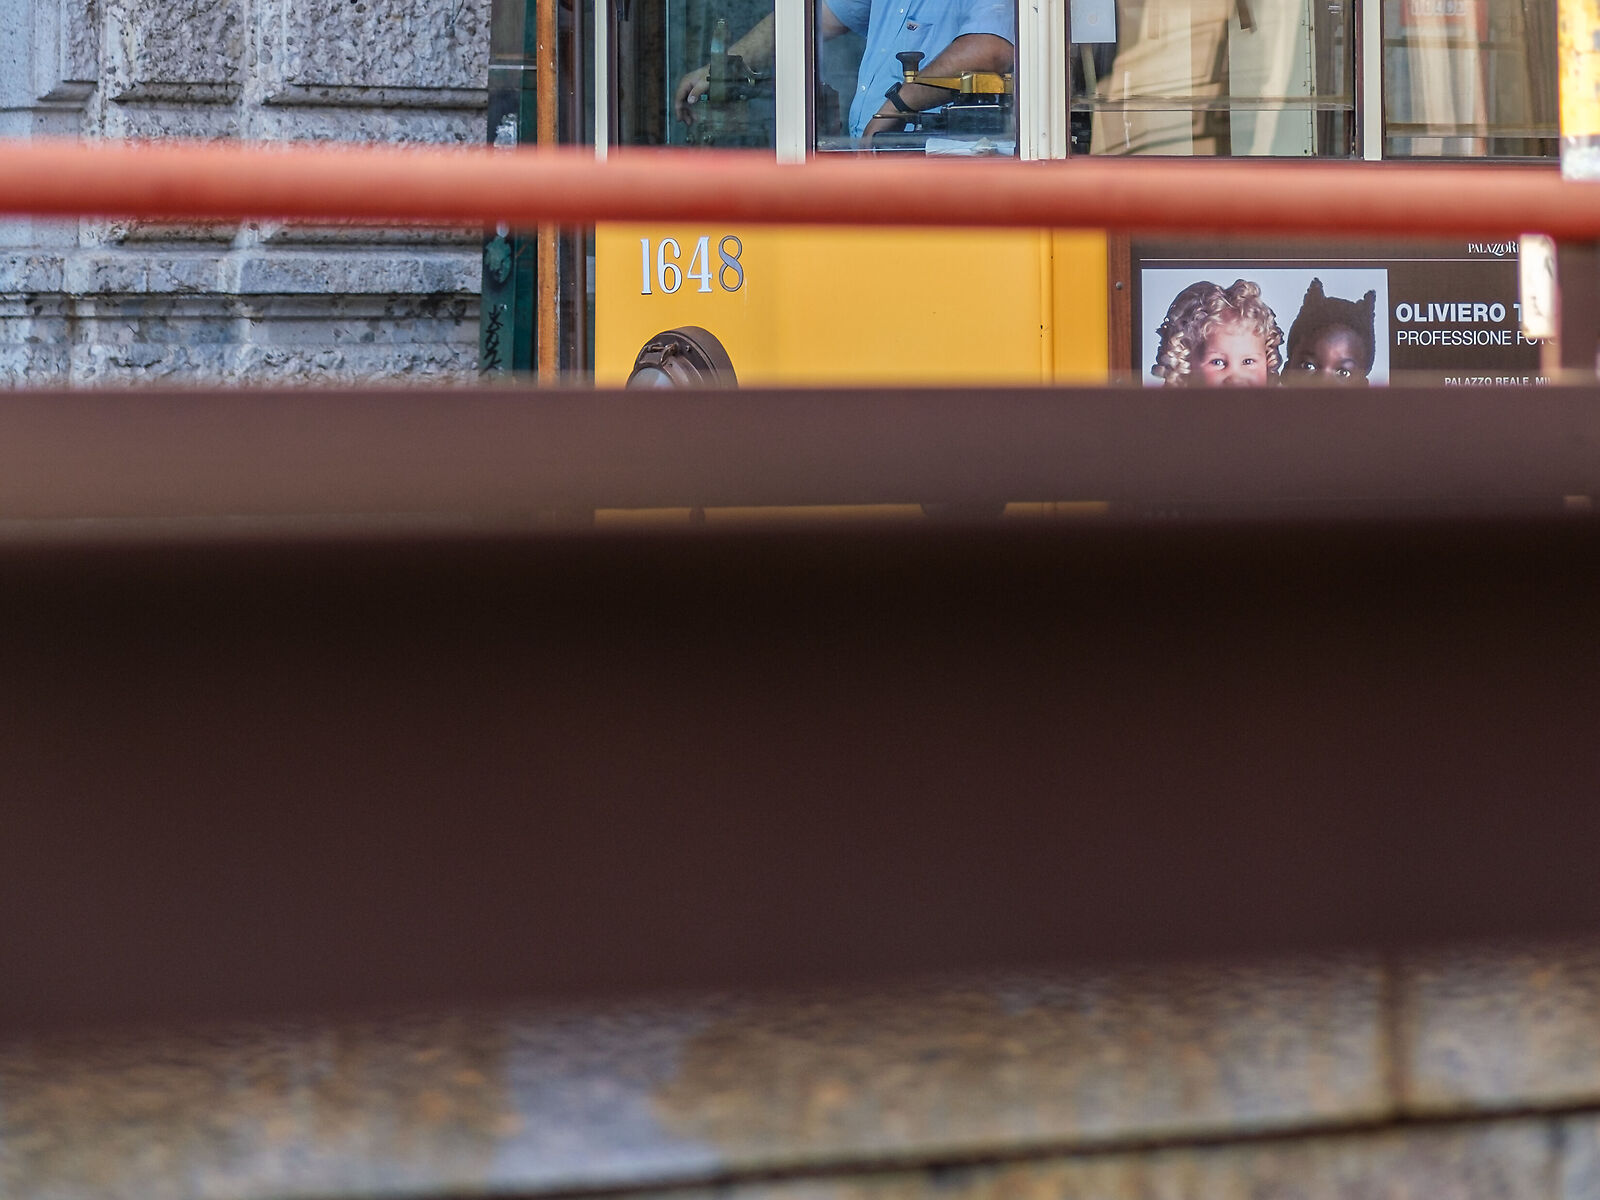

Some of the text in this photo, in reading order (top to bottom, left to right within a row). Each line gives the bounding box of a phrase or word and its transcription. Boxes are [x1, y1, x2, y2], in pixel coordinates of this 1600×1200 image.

[1468, 241, 1520, 256] PALAZZOR
[640, 235, 744, 295] 1648
[1395, 303, 1506, 322] OLIVIERO
[1397, 330, 1512, 346] PROFESSIONE
[1444, 377, 1492, 387] PALAZZO
